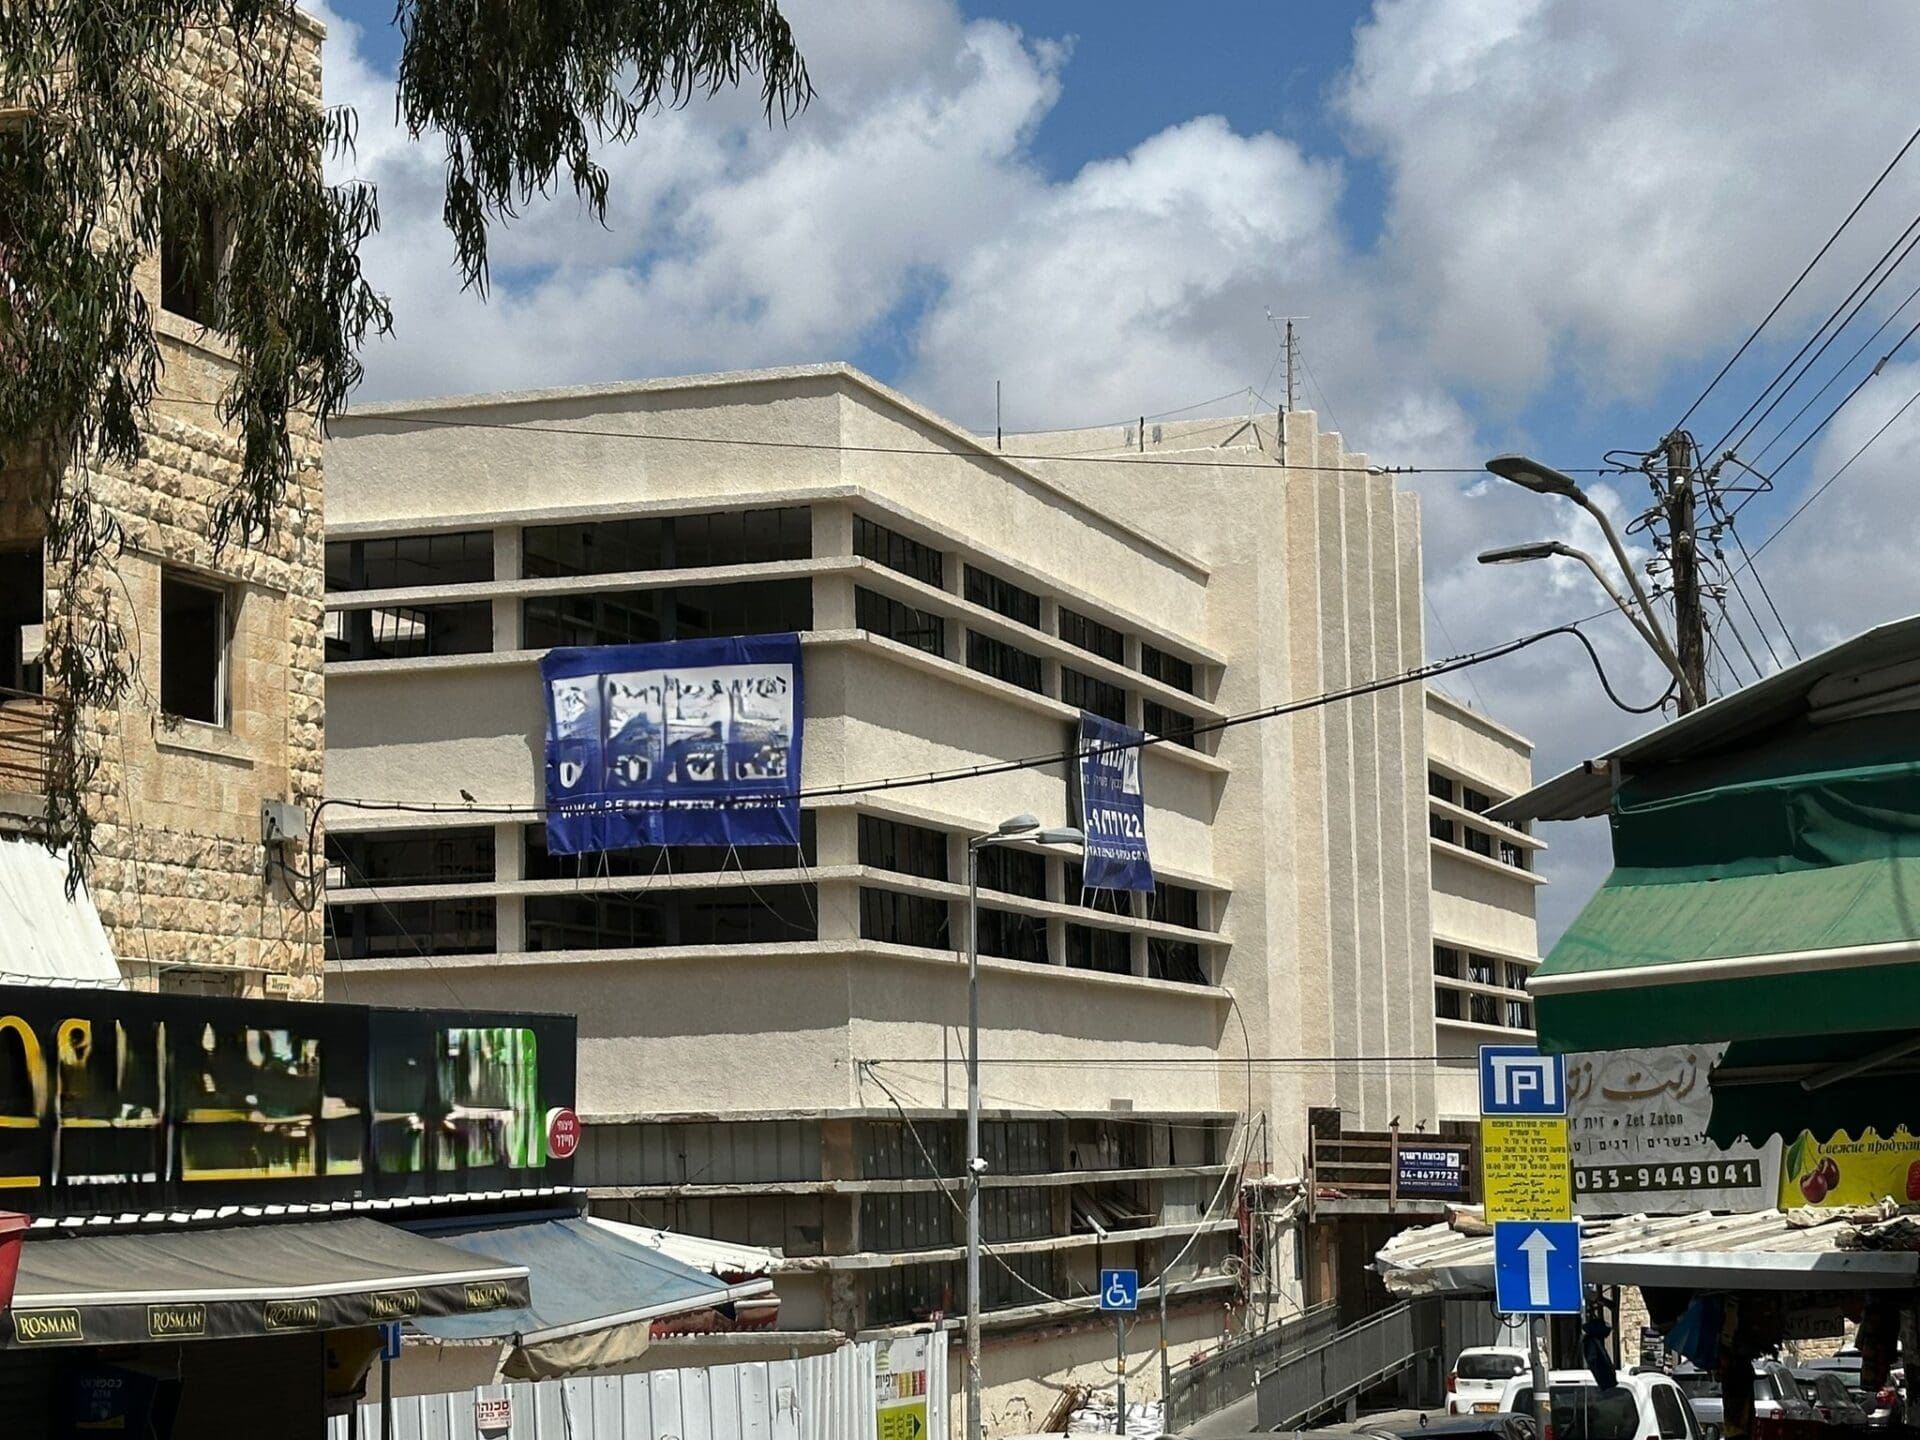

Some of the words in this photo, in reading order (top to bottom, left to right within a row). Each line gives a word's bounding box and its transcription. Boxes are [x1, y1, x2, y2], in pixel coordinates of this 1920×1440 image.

[1626, 1114, 1645, 1127] Zet
[1650, 1112, 1684, 1126] Zaton
[1400, 1170, 1458, 1180] 04-8677722
[1575, 1163, 1753, 1190] 053-9449041
[20, 1315, 77, 1338] ROSMAN
[153, 1311, 201, 1332] ROSMAN
